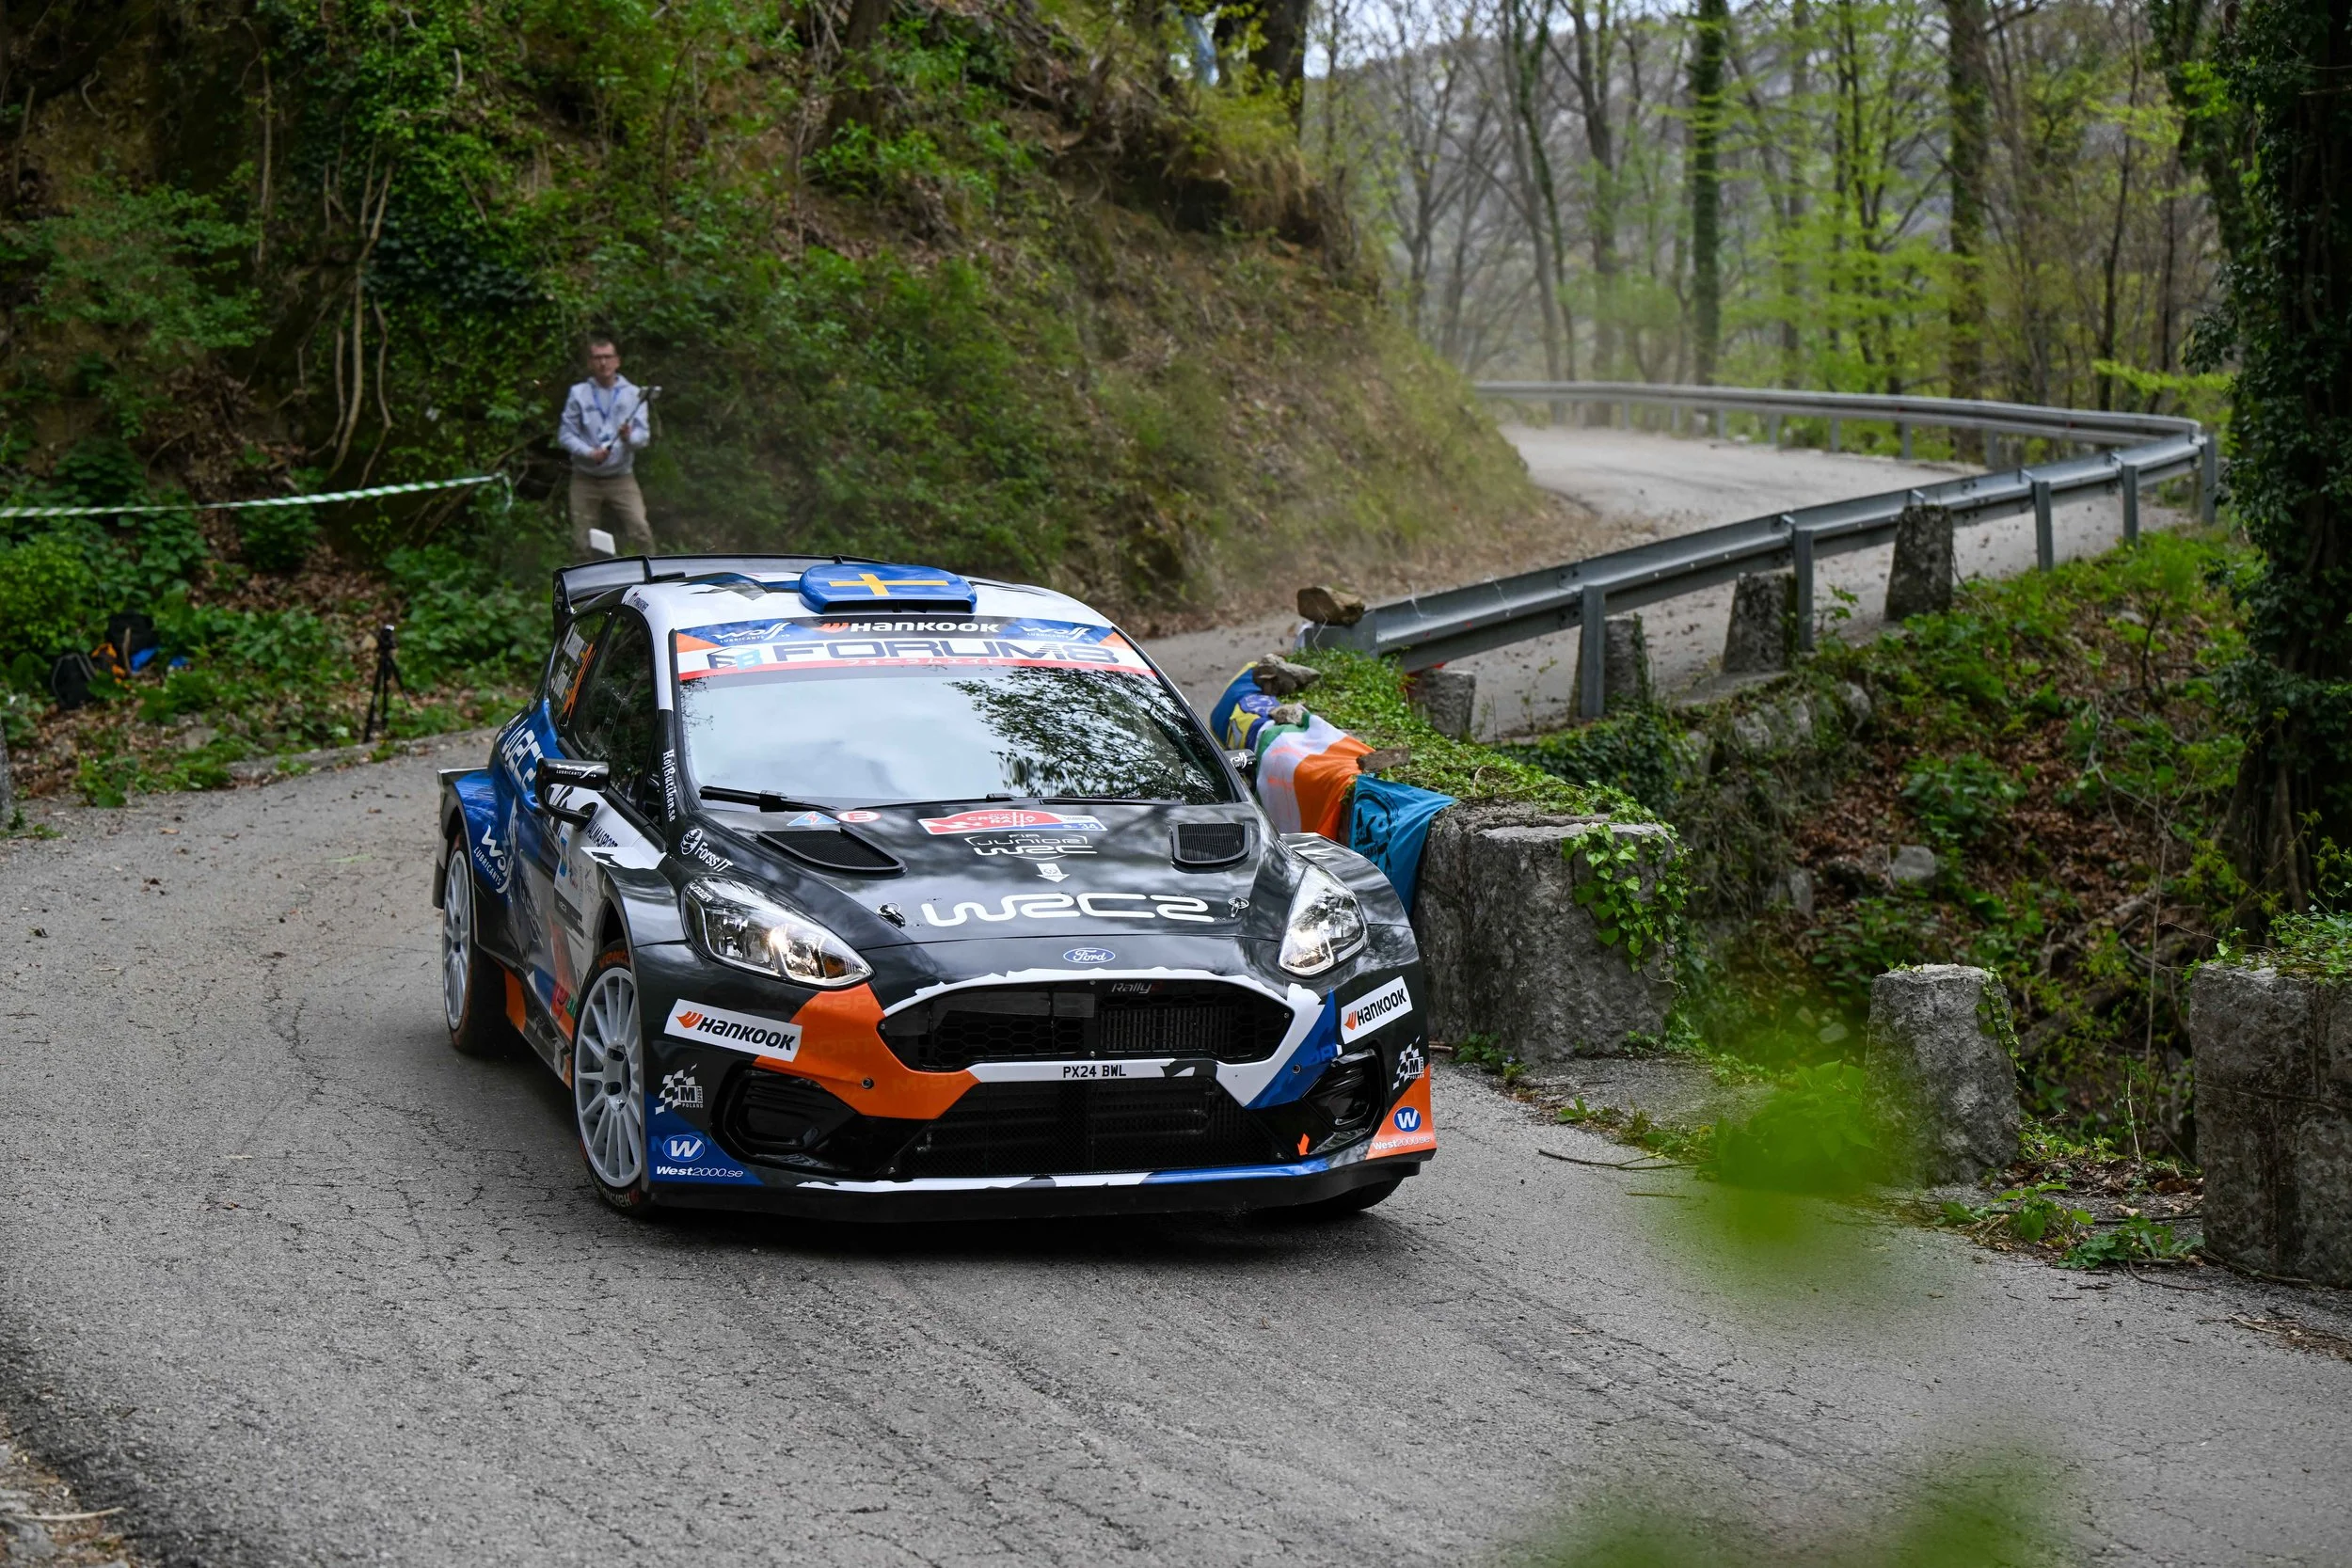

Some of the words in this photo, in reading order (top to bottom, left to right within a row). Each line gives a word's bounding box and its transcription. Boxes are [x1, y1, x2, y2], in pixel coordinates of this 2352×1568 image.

[772, 641, 1120, 664] FORUM8
[977, 837, 1083, 846] JUNIOR
[694, 842, 718, 867] Forss
[717, 859, 734, 873] IT
[474, 846, 502, 887] LUBRICANTS
[1072, 948, 1107, 963] Ford
[1063, 1066, 1097, 1078] PX24
[1102, 1065, 1127, 1077] BWL
[656, 1165, 744, 1179] West2000.se
